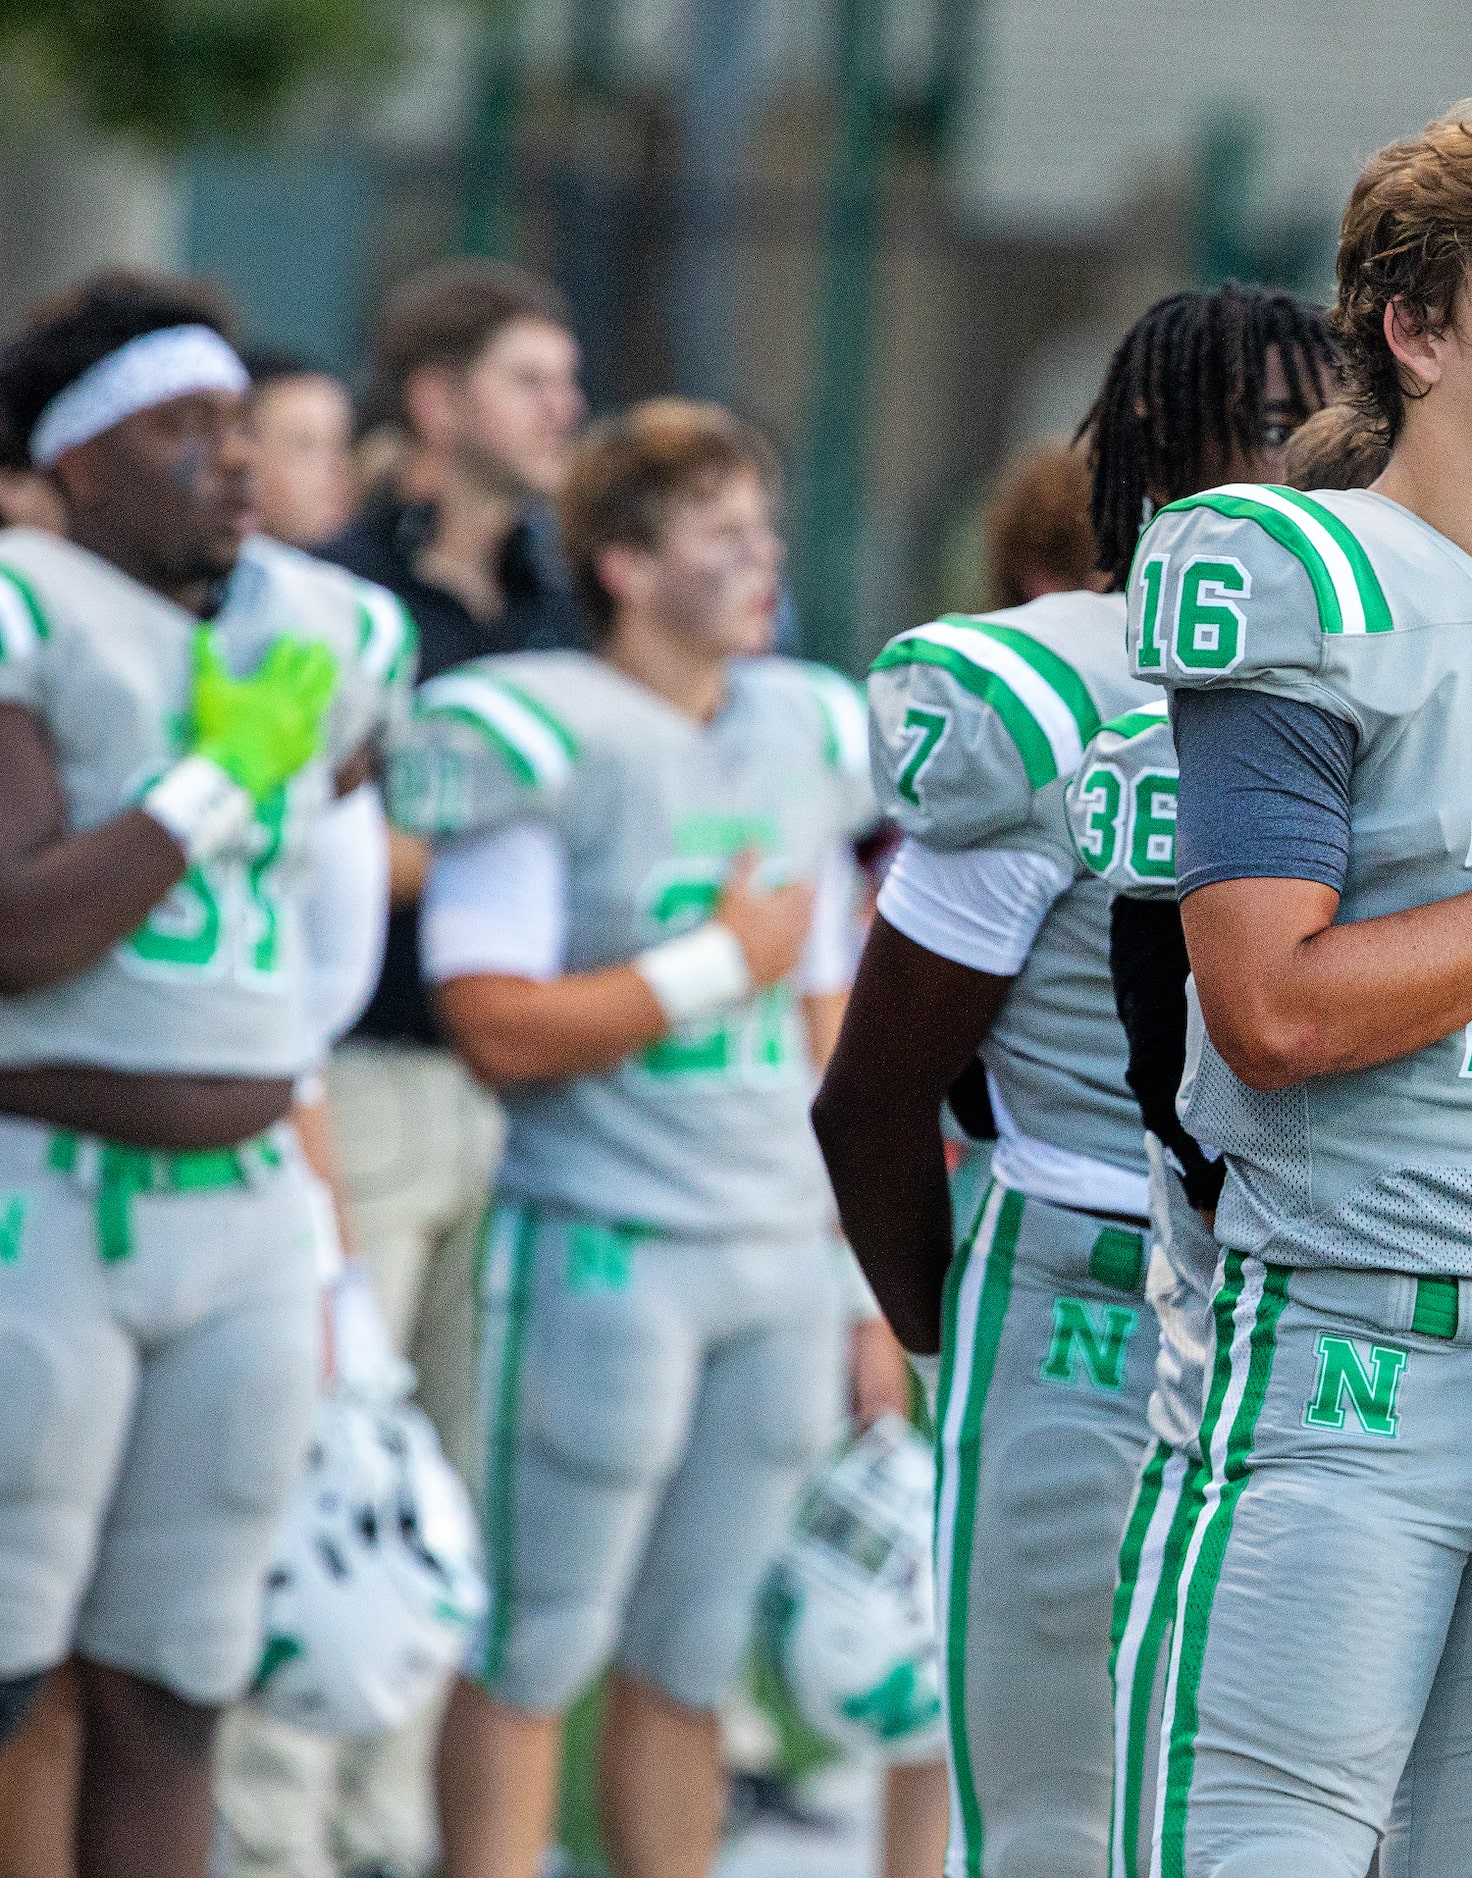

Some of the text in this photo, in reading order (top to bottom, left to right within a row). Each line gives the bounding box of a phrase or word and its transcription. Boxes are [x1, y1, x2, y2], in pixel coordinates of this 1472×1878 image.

[1136, 553, 1251, 674] 16
[896, 702, 951, 807] 7
[1077, 763, 1179, 885] 36
[1040, 1296, 1139, 1393] N
[1305, 1334, 1408, 1438] N
